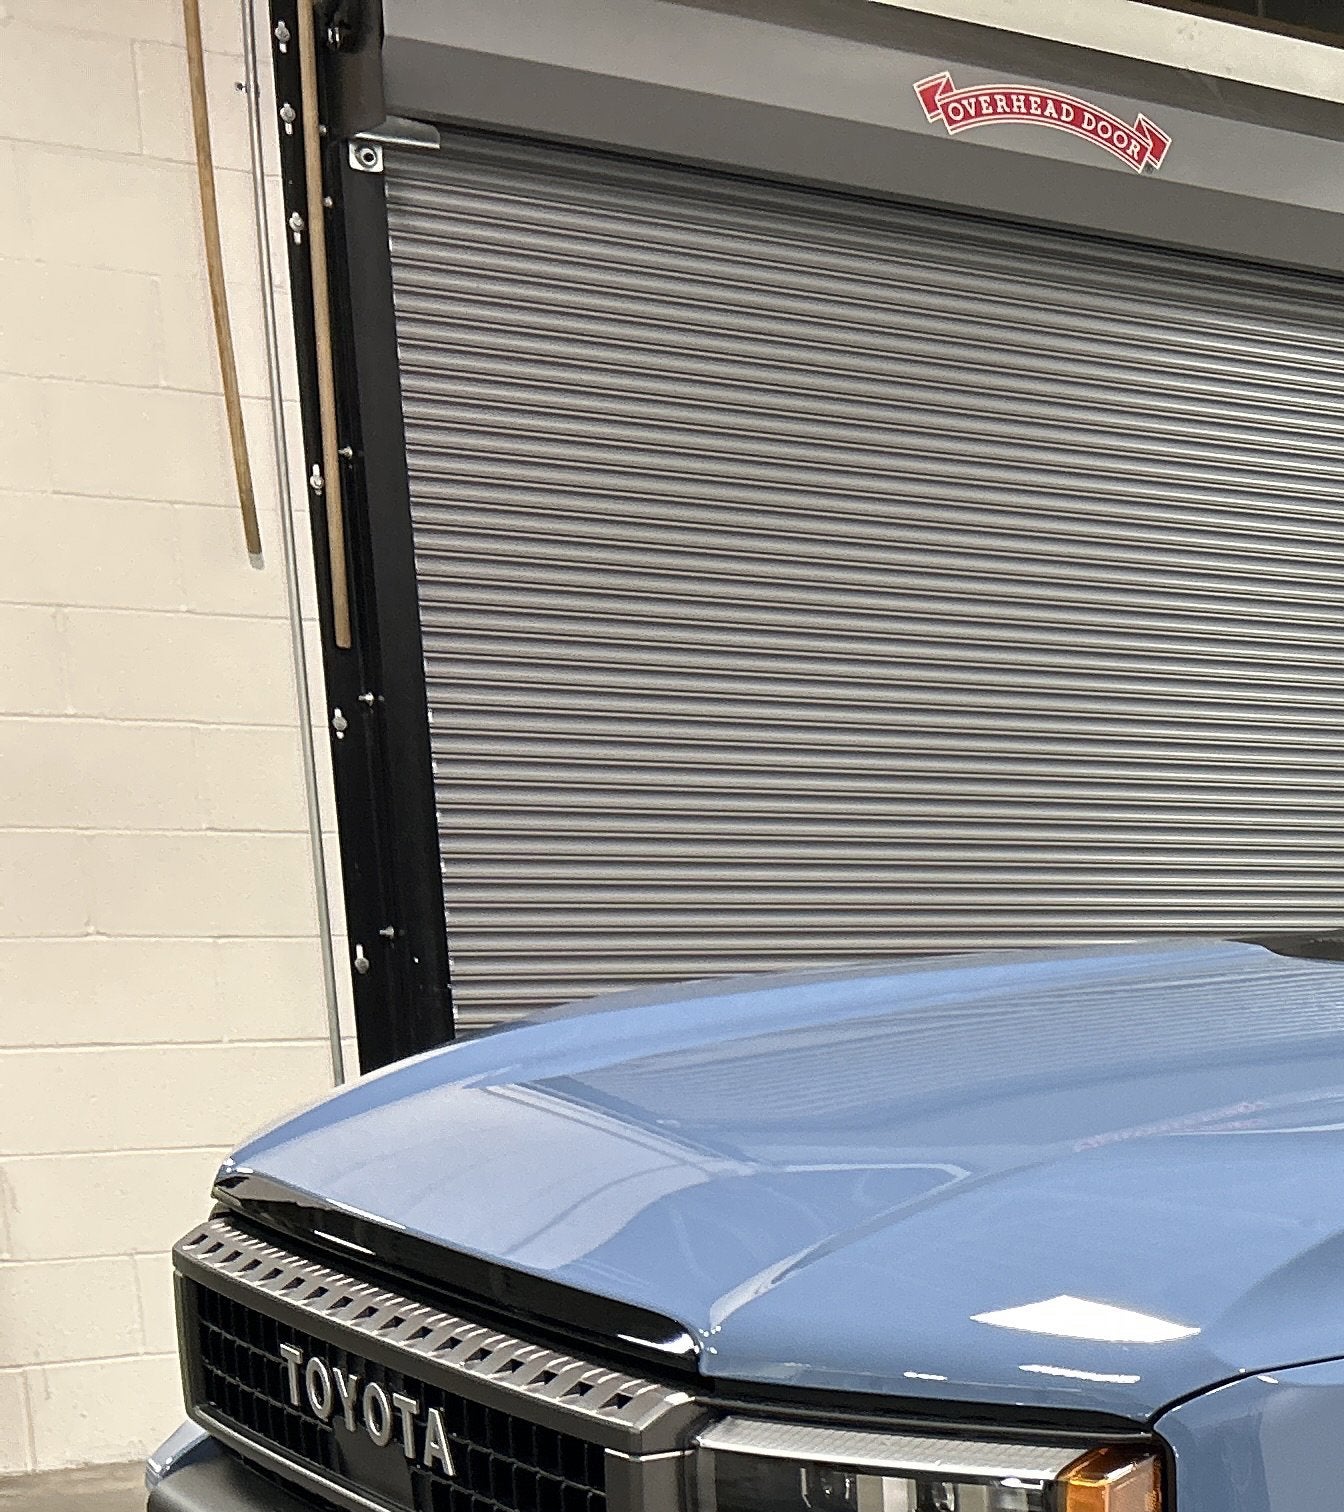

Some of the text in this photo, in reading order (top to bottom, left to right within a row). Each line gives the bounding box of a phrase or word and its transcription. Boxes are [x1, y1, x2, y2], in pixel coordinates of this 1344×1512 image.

[947, 94, 1142, 161] OVERHEAD DOOR
[279, 1342, 457, 1477] TOYOTA
